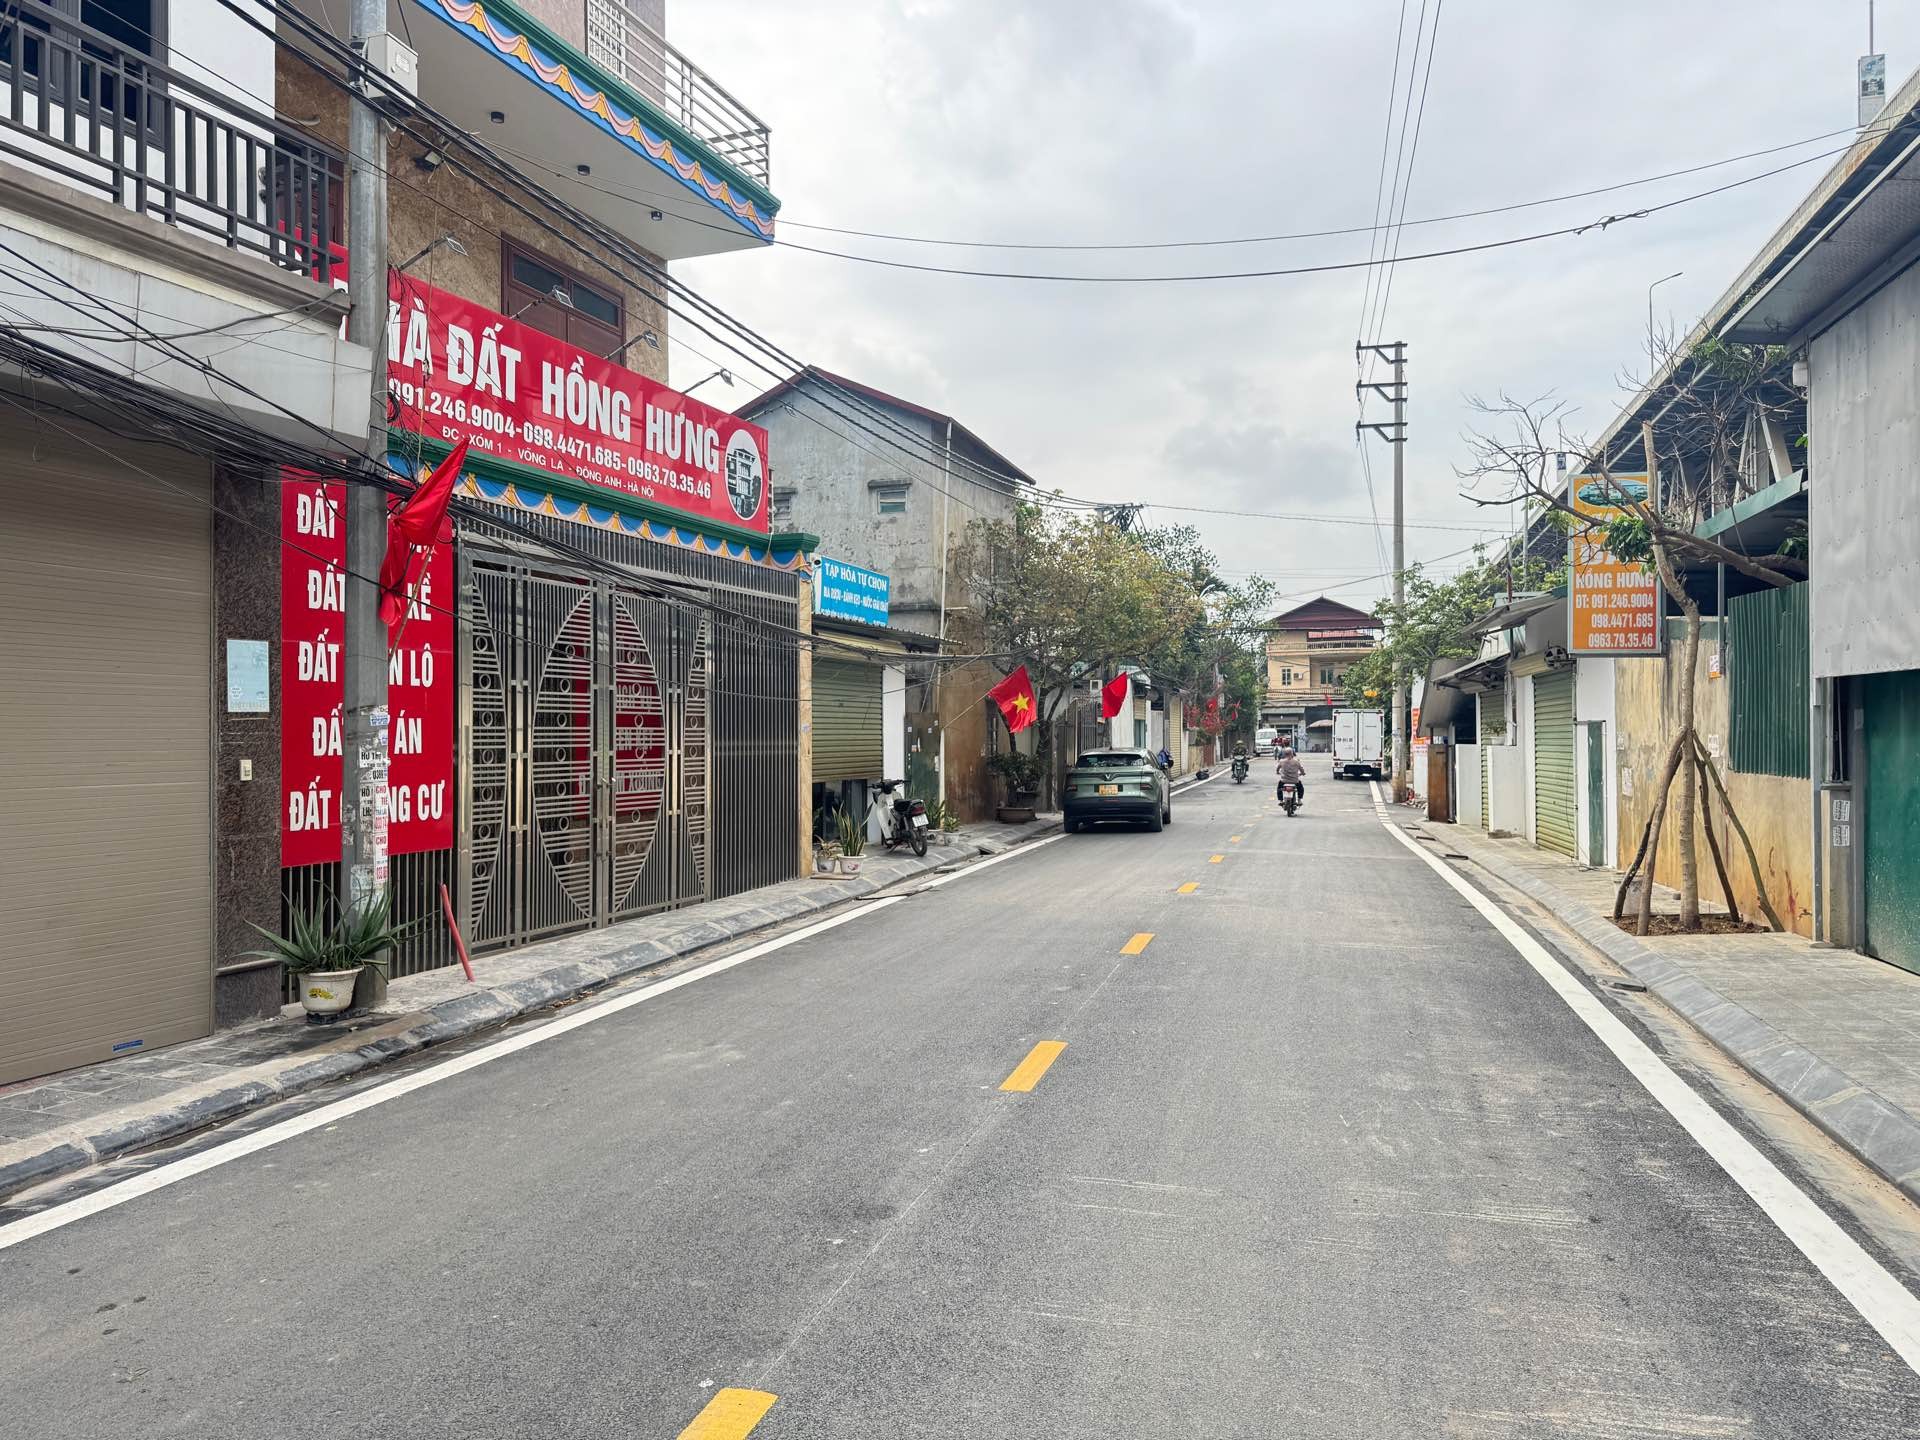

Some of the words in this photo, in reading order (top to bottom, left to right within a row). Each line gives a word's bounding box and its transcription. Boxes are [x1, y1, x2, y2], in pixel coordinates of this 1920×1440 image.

[445, 323, 521, 403] ĐẤT
[542, 355, 631, 443] HỒNG
[645, 403, 720, 474] HƯNG
[469, 432, 493, 451] XÓM
[497, 442, 502, 453] 1
[518, 446, 546, 466] VÕNG
[550, 458, 564, 471] LA
[576, 465, 602, 482] ĐÔNG
[604, 475, 622, 488] ANH
[641, 484, 655, 498] NỘI
[297, 483, 337, 539] ĐẤT
[825, 563, 839, 579] TẠP
[868, 576, 887, 592] CHỌN
[1576, 569, 1612, 589] HỒNG
[1617, 572, 1654, 589] HƯNG
[1592, 594, 1653, 608] 091.246.9004
[1588, 633, 1653, 648] 0963.79.35.46
[1591, 614, 1653, 628] 098.4471.685
[298, 628, 339, 682] ĐẤT
[410, 643, 433, 688] LÔ
[312, 702, 343, 757] ĐẤ
[393, 709, 422, 755] ÁN
[289, 777, 331, 832] ĐẤT
[417, 780, 445, 822] CƯ
